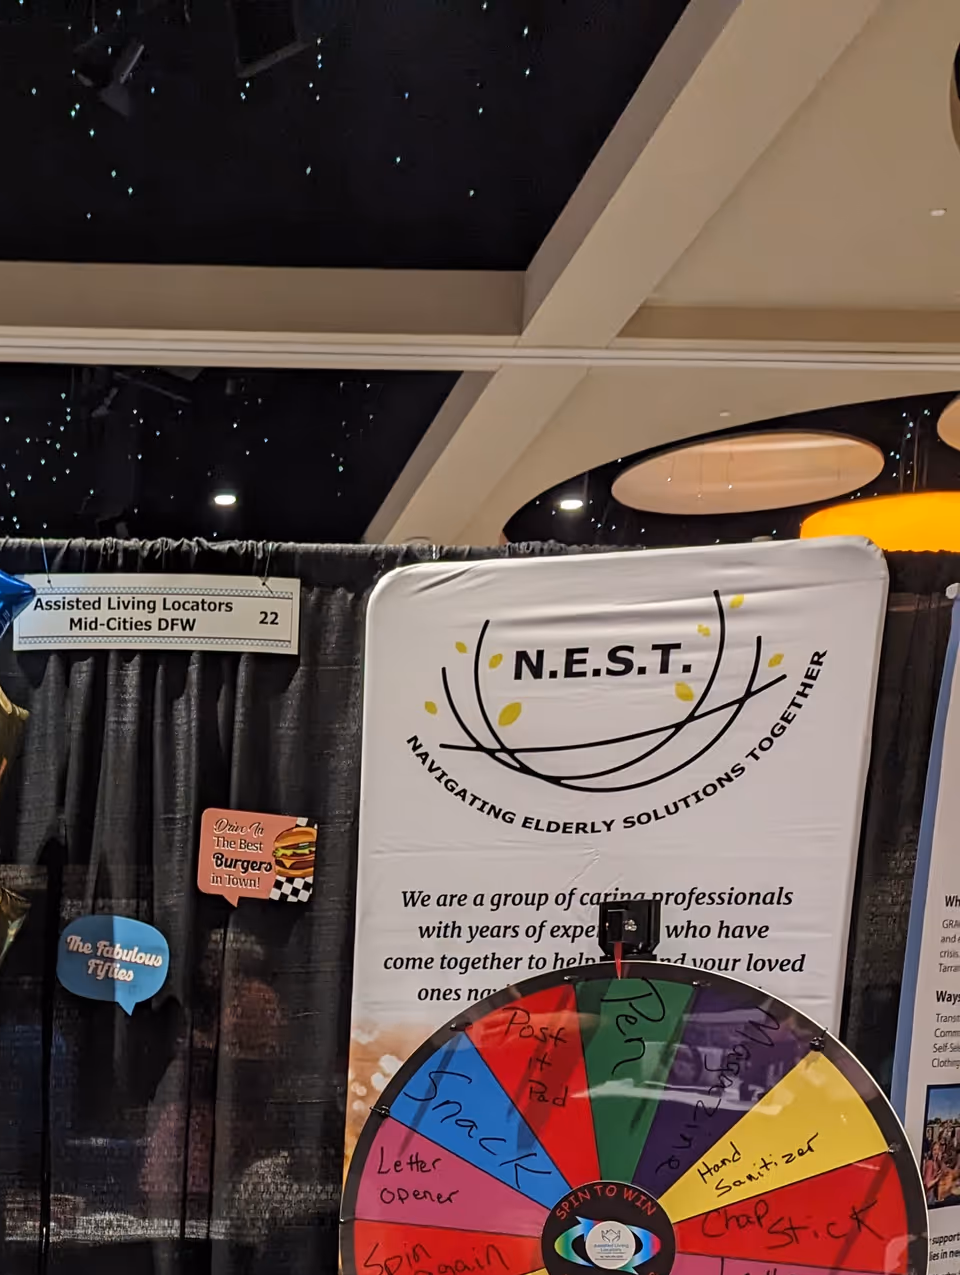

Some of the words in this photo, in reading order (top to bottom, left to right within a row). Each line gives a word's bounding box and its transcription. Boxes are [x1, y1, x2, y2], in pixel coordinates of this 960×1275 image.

[33, 596, 102, 611] Assisted
[108, 597, 157, 614] Living
[162, 598, 234, 612] Locators
[69, 617, 152, 632] Mid-Cities
[157, 618, 197, 632] DFW
[258, 611, 279, 626] 22
[514, 642, 692, 680] N.E.S.T.
[405, 735, 516, 826] NAVIGATING
[521, 816, 615, 834] ELDERLY
[622, 762, 746, 829] SOLUTIONS
[744, 649, 828, 762] TOGETHER
[214, 818, 246, 836] Drive
[248, 822, 264, 837] In
[214, 836, 236, 851] The
[239, 838, 264, 852] Best
[212, 852, 272, 874] Burgers
[225, 874, 260, 889] Town!
[402, 891, 431, 907] We
[436, 893, 467, 907] are
[490, 892, 549, 911] group
[419, 921, 462, 938] with
[466, 923, 520, 943] years
[665, 920, 711, 938] who
[717, 920, 769, 938] have
[67, 936, 92, 954] The
[96, 941, 163, 968] Fabulous
[384, 956, 434, 970] come
[440, 953, 522, 974] together
[691, 956, 741, 972] your
[746, 953, 806, 972] loved
[88, 960, 134, 982] Fifties
[418, 986, 461, 1001] ones
[503, 1006, 568, 1045] Post
[601, 977, 665, 1075] Pen
[528, 1079, 568, 1108] Pad
[655, 1006, 780, 1175] Magazine
[377, 1146, 442, 1175] Letter
[697, 1141, 741, 1184] Hand
[714, 1132, 819, 1198] Sanitizer
[556, 1190, 591, 1220] SPIN
[594, 1185, 617, 1197] TO
[623, 1187, 656, 1216] WIN
